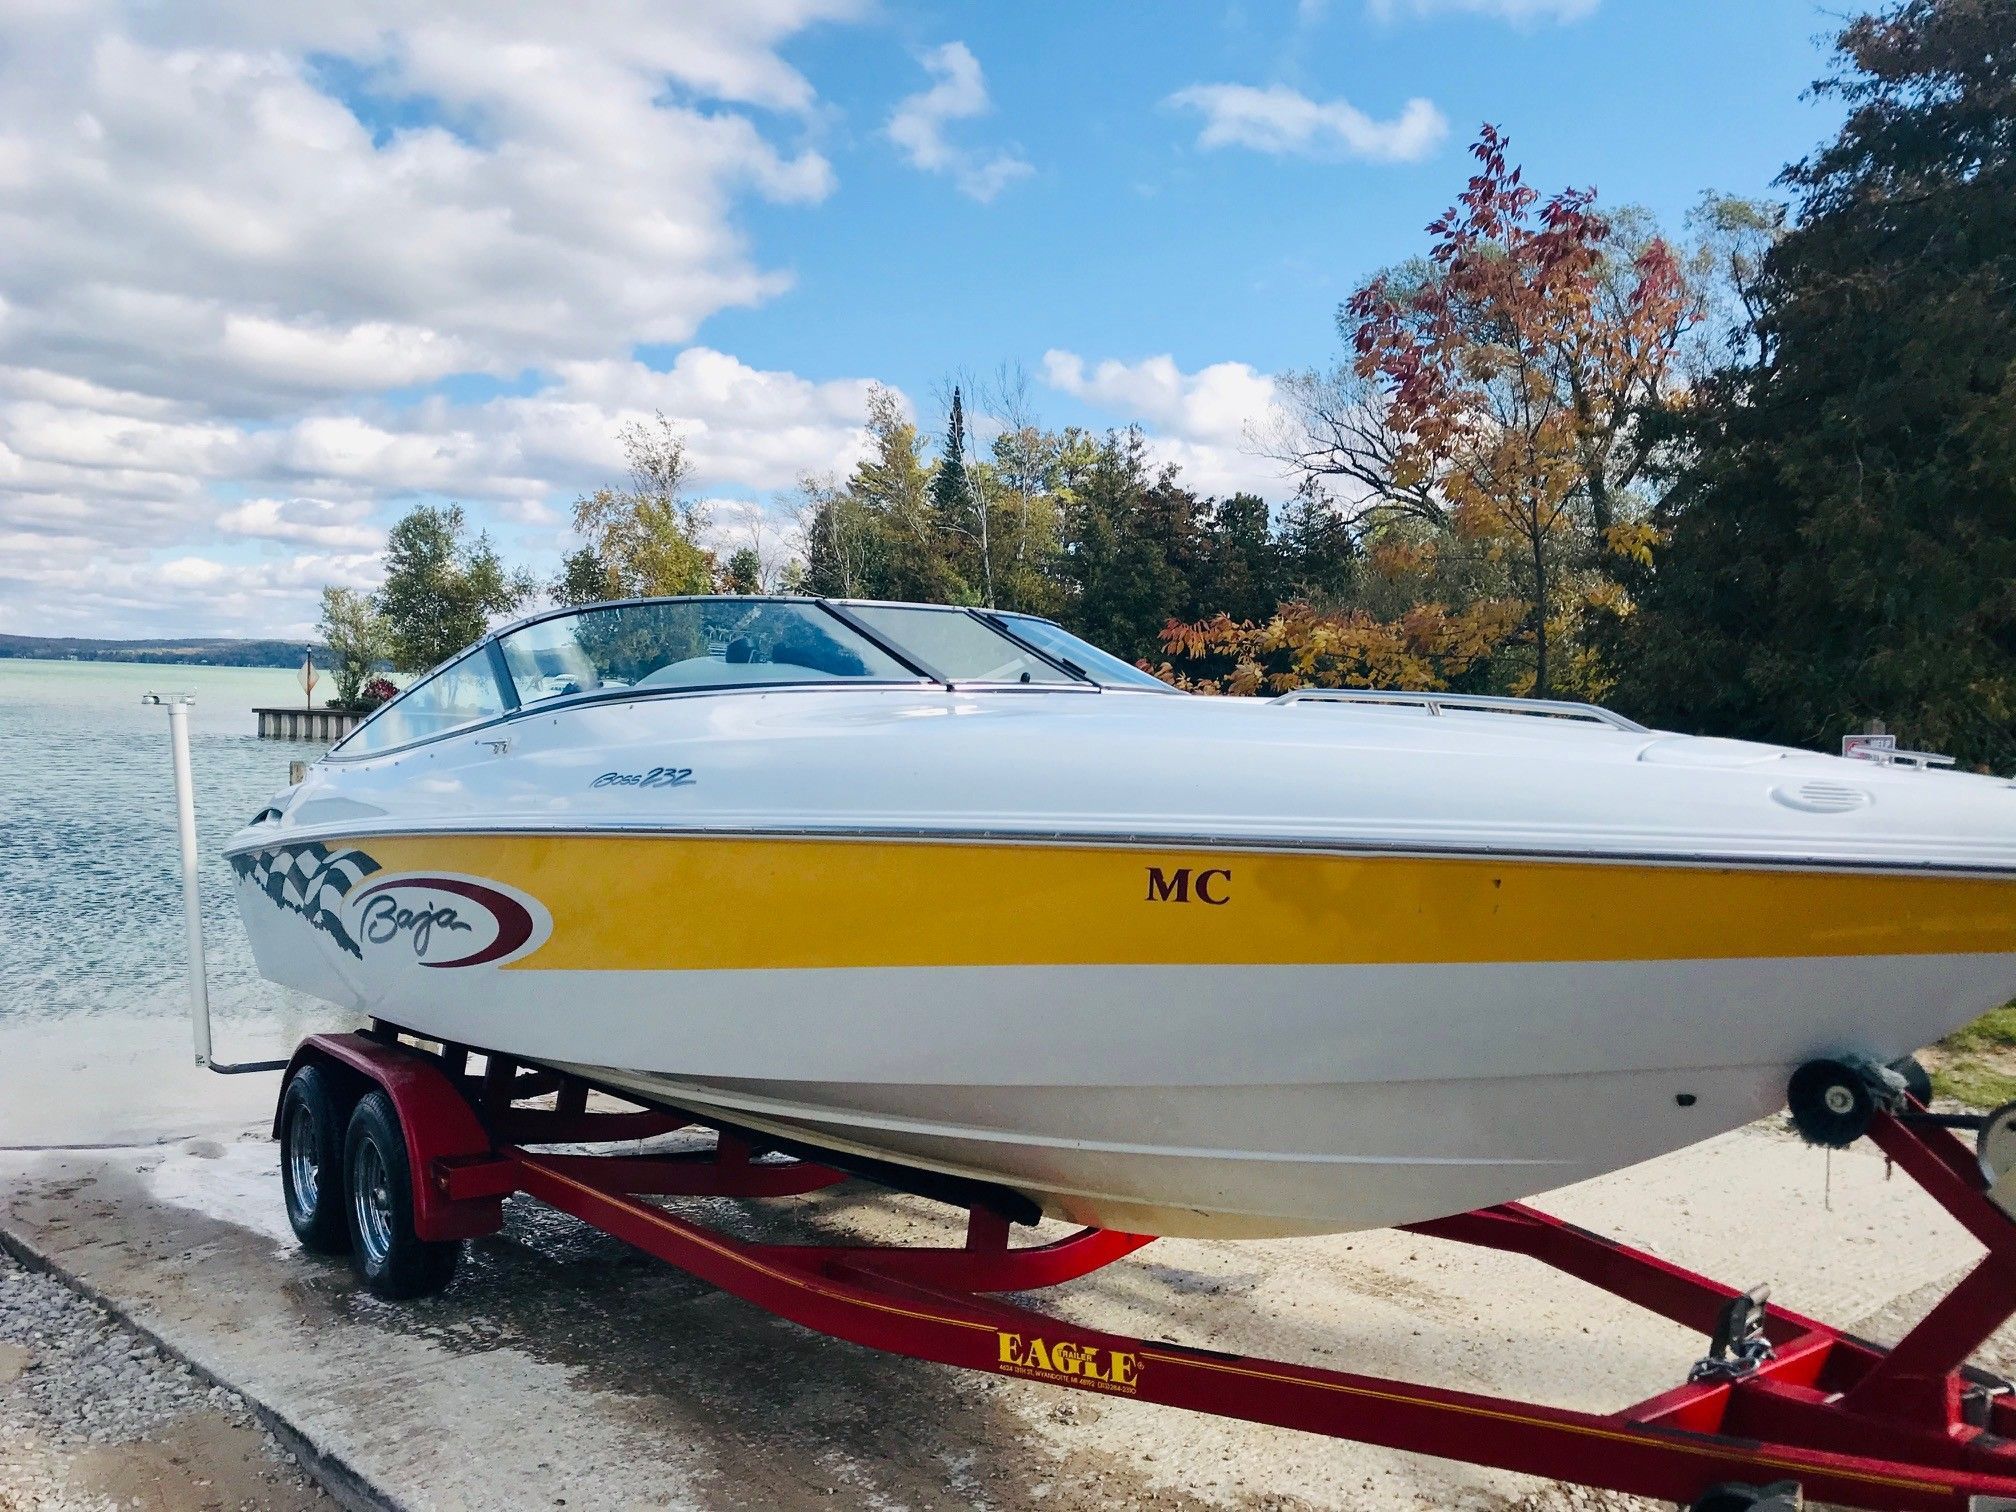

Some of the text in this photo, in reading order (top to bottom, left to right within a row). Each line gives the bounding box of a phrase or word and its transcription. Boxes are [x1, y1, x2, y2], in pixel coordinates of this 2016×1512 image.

[639, 767, 697, 788] 232
[1144, 867, 1231, 905] MC
[360, 894, 472, 957] Baja
[997, 1332, 1138, 1388] EAGLE
[1057, 1349, 1092, 1362] TRAILER
